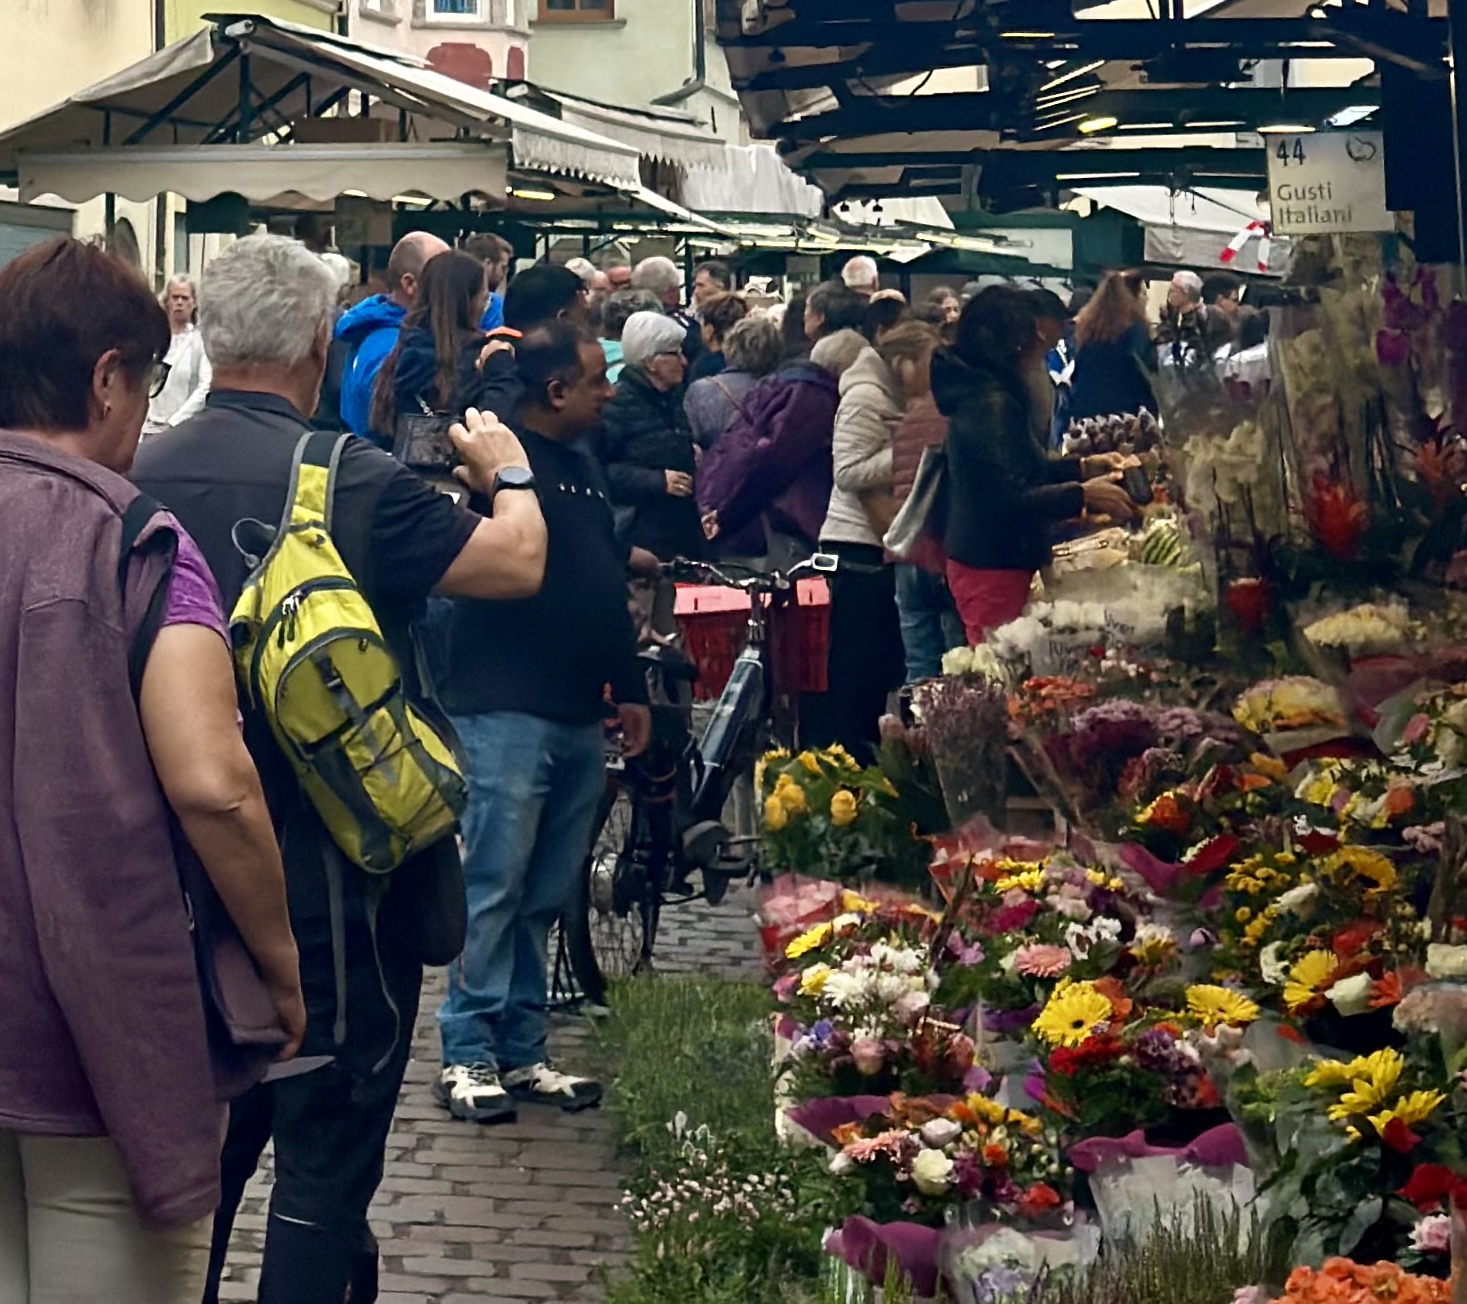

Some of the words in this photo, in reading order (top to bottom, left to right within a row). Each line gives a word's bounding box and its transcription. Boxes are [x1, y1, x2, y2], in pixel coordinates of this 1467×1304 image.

[1275, 137, 1306, 167] 44
[1277, 180, 1333, 202] Gusti
[1278, 202, 1354, 228] Italiani
